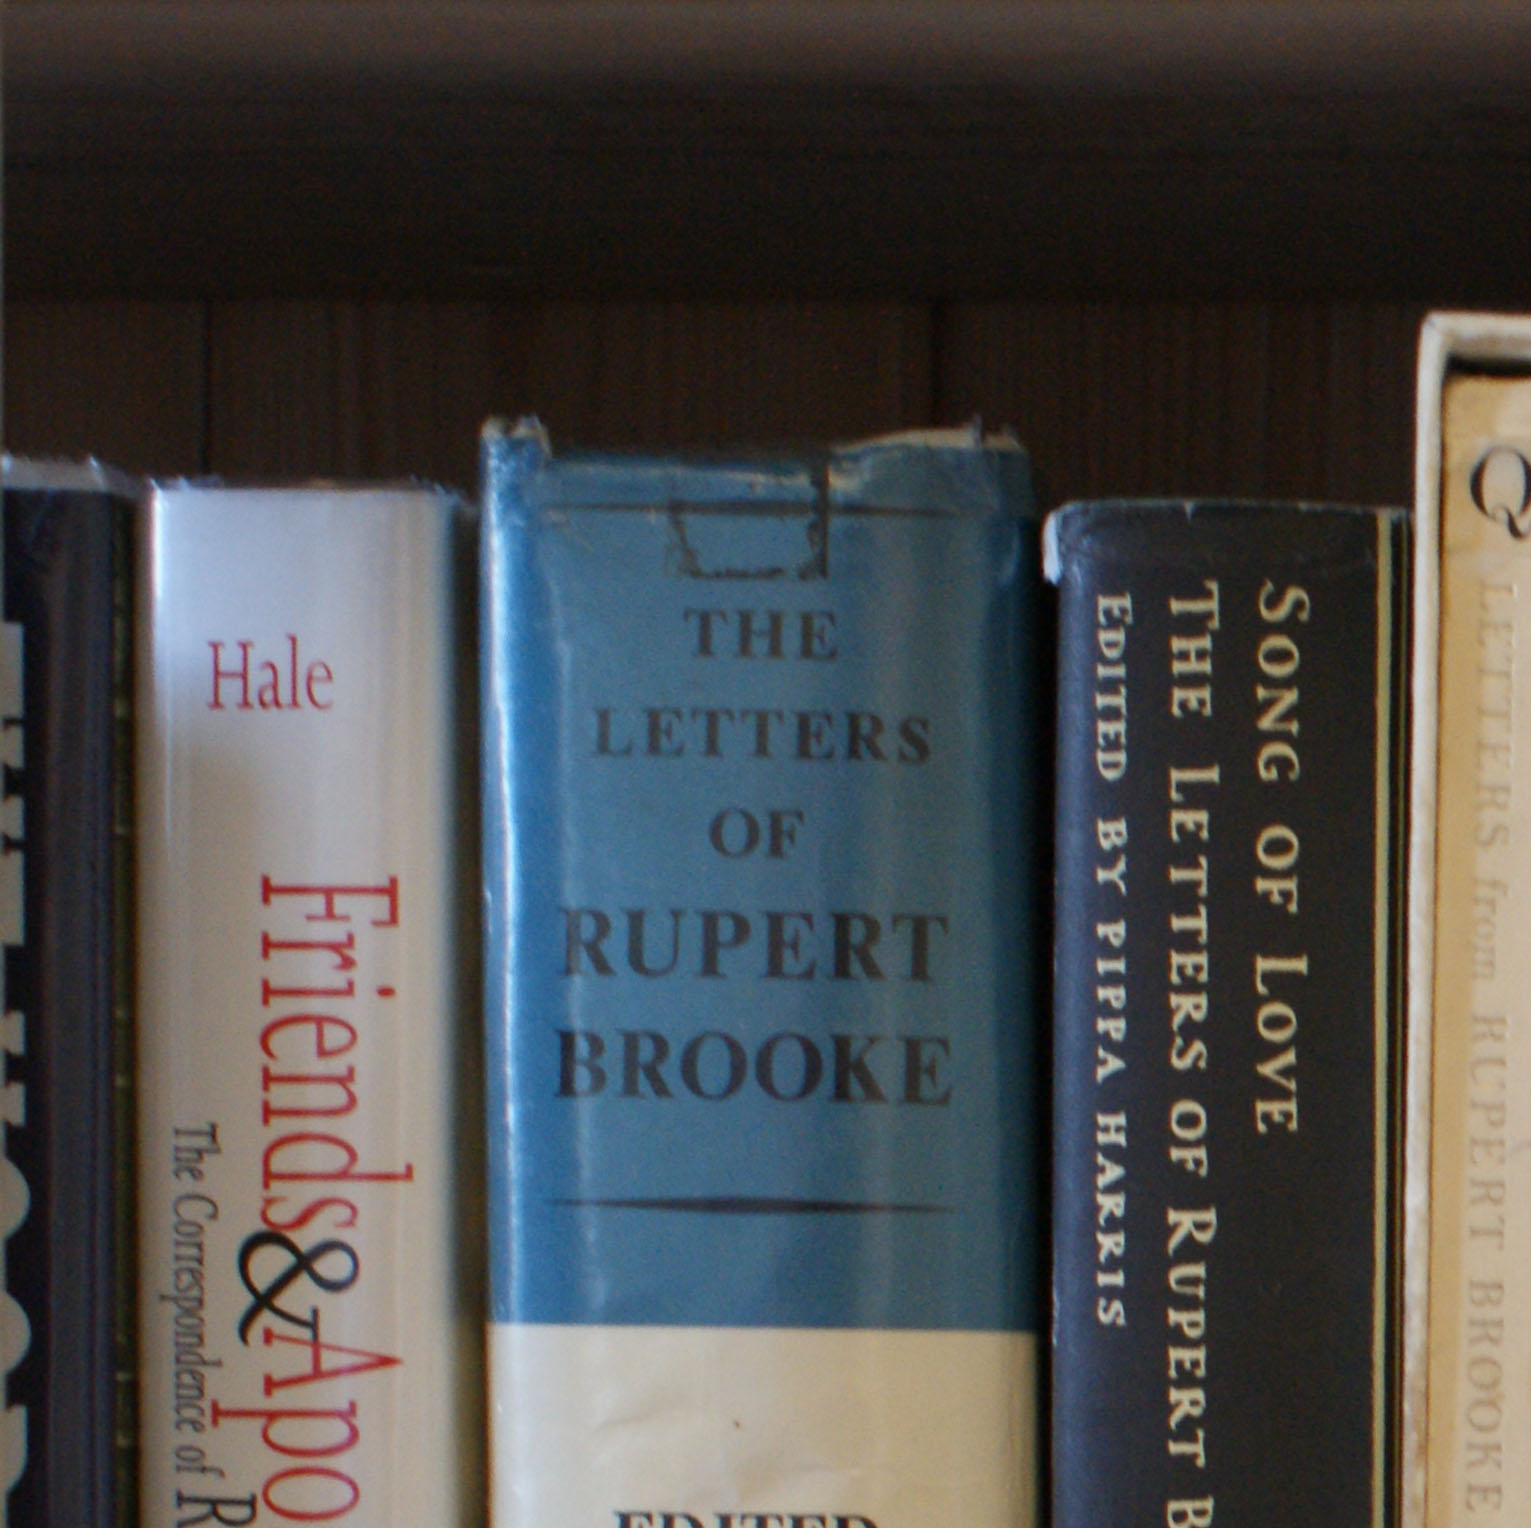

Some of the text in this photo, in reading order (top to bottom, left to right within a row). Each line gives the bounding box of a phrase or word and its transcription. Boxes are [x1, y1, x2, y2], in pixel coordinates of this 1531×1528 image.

[205, 634, 334, 713] Hale
[683, 608, 839, 662] THE
[1168, 577, 1221, 720] THE
[593, 706, 933, 765] LETTERS
[708, 808, 805, 861] OF
[1254, 823, 1302, 914] OF
[557, 906, 951, 983] RUPERT
[1166, 762, 1221, 1074] LETTERS
[1093, 590, 1134, 1329] EDITED BY PIPPA HARRIS
[553, 1029, 953, 1106] BROOKE
[1253, 954, 1309, 1136] LOVE
[172, 1120, 223, 1184] The
[1168, 1097, 1211, 1178] OF
[158, 1192, 223, 1434] Correspondence
[1165, 1205, 1219, 1470] RUPERT
[174, 1443, 226, 1479] of
